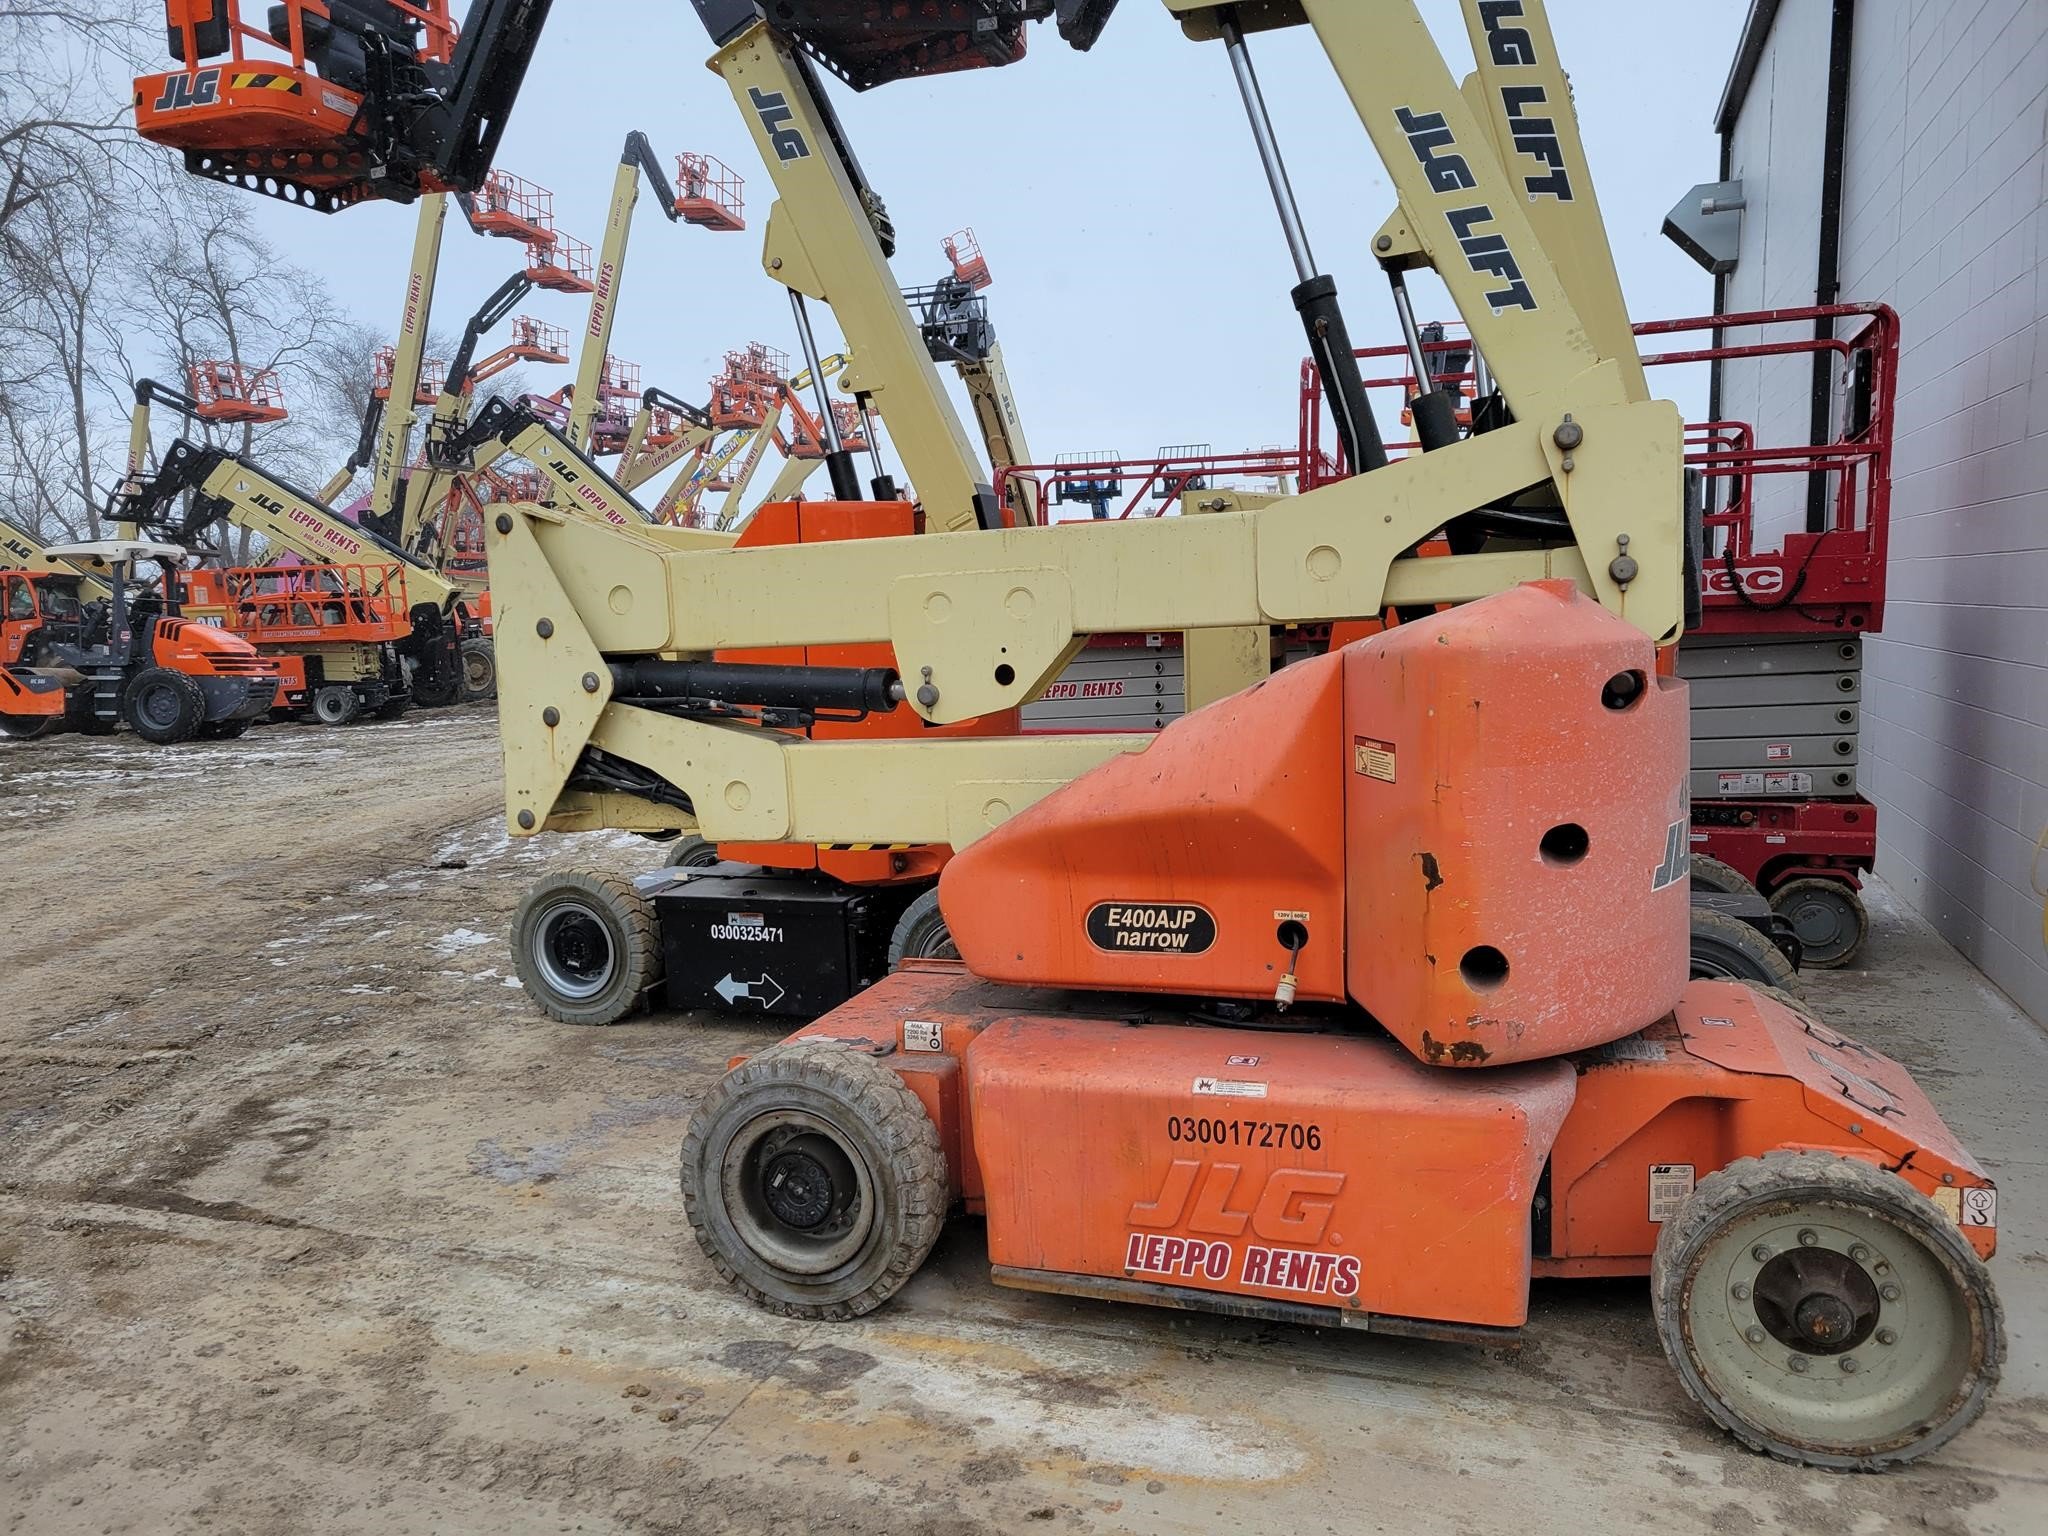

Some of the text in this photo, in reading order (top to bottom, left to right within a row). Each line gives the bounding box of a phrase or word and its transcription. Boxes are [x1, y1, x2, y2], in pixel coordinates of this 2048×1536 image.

[153, 68, 221, 112] JLG
[1477, 0, 1574, 202] LG LIFT
[747, 86, 811, 161] JLG
[1392, 105, 1540, 311] JLG LIFT
[404, 273, 422, 335] LEPPO RENTS
[590, 262, 613, 338] LEPPO RENTS
[385, 431, 395, 458] LIFT
[651, 437, 691, 467] LEPPO RENTS
[704, 436, 739, 477] AUTISM
[548, 460, 579, 483] JLG
[248, 493, 285, 516] JLG
[577, 484, 627, 525] LEPPO REN
[2, 538, 34, 559] JLG
[288, 508, 361, 555] LEPPO RENTS
[254, 549, 270, 567] LIFT
[280, 677, 297, 685] ENTS
[1041, 681, 1123, 699] EPPO RENTS
[1651, 818, 1690, 893] JL
[711, 924, 783, 942] 0300325471
[1107, 908, 1196, 929] E400AJP
[1116, 930, 1189, 947] narrow
[1168, 1116, 1321, 1150] 0300172706
[1127, 1160, 1347, 1246] JLG
[1126, 1233, 1361, 1297] LEPPO RENTS
